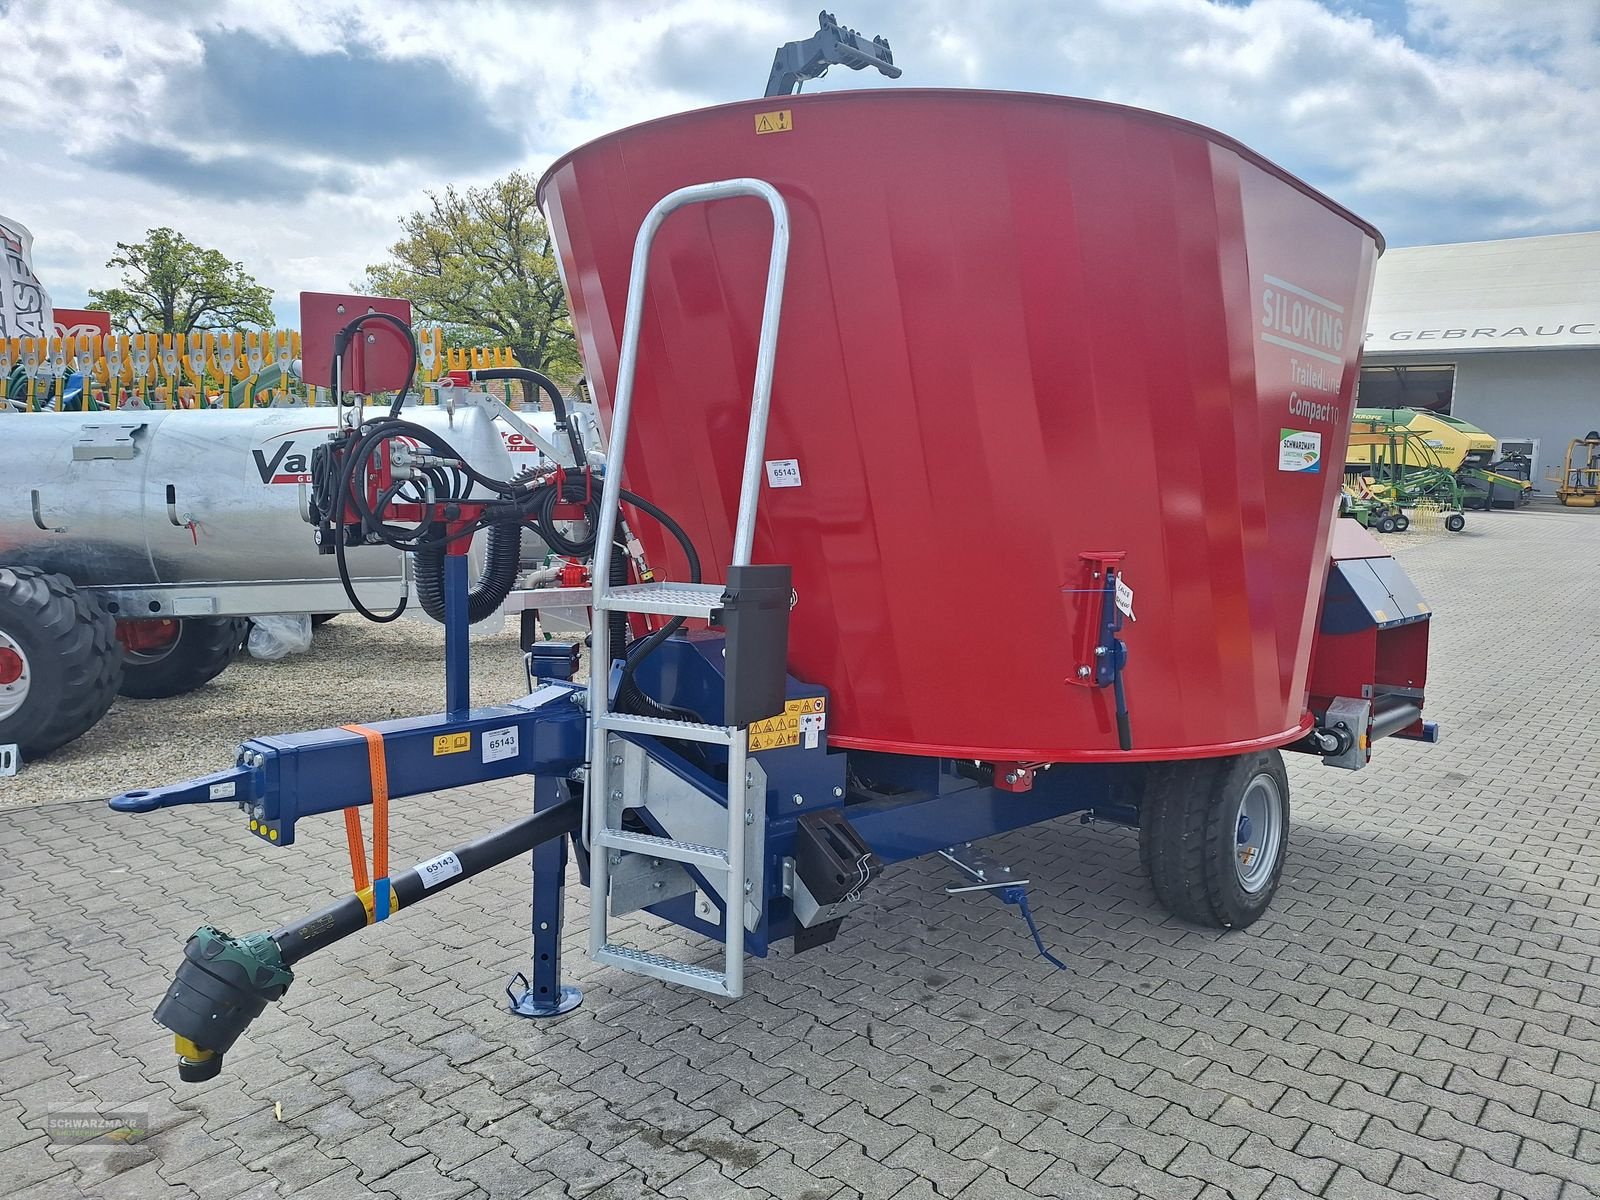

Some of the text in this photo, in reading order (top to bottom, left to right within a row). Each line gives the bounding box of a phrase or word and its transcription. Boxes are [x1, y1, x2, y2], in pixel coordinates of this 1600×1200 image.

[6, 253, 46, 339] ASE
[1262, 289, 1343, 351] SILOKING
[1389, 323, 1600, 341] GEBRAUC
[1290, 358, 1340, 394] TrailedLine
[1288, 391, 1330, 425] Compact
[251, 440, 308, 484] Va
[774, 468, 796, 477] 65143
[489, 736, 515, 749] 65143
[425, 856, 454, 873] 65143
